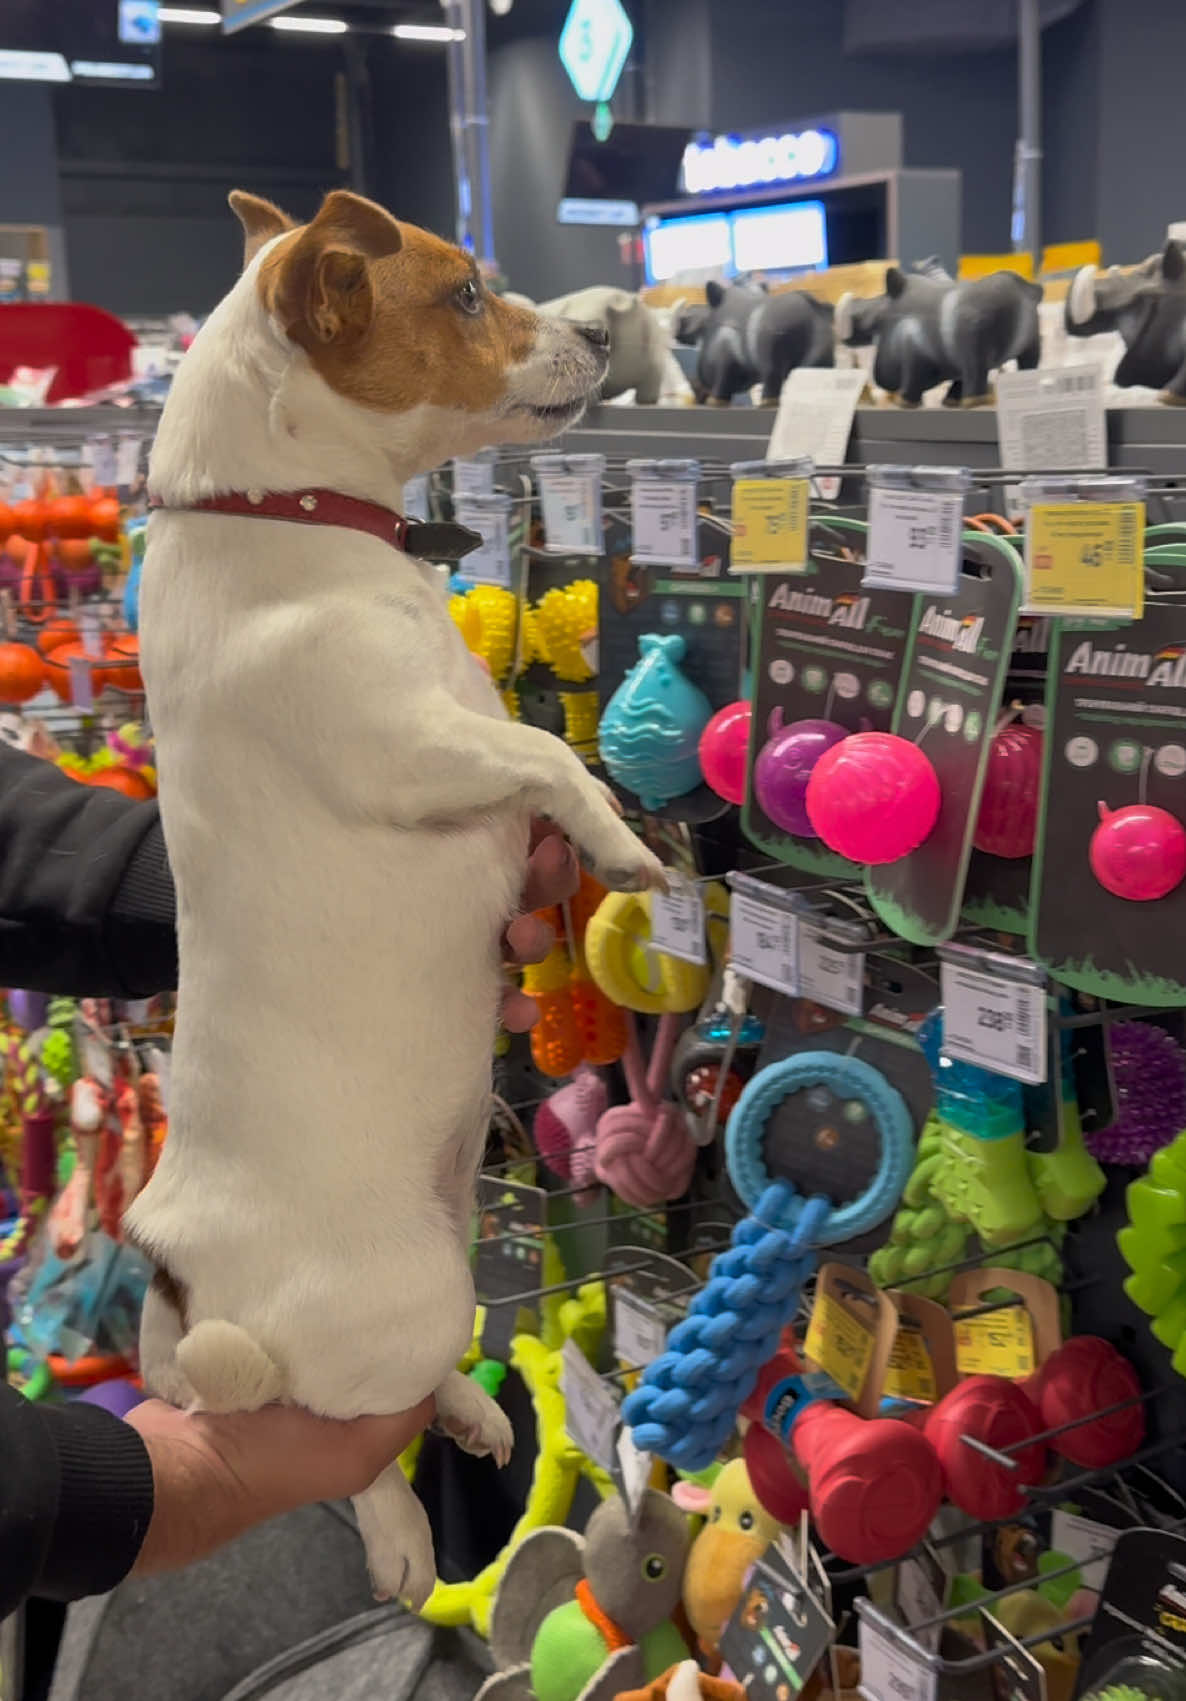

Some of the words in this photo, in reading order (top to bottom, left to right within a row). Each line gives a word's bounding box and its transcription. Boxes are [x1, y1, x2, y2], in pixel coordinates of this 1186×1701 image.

[768, 582, 871, 630] AnimAll
[918, 605, 985, 654] AnimAll
[1064, 640, 1186, 688] AnimAl
